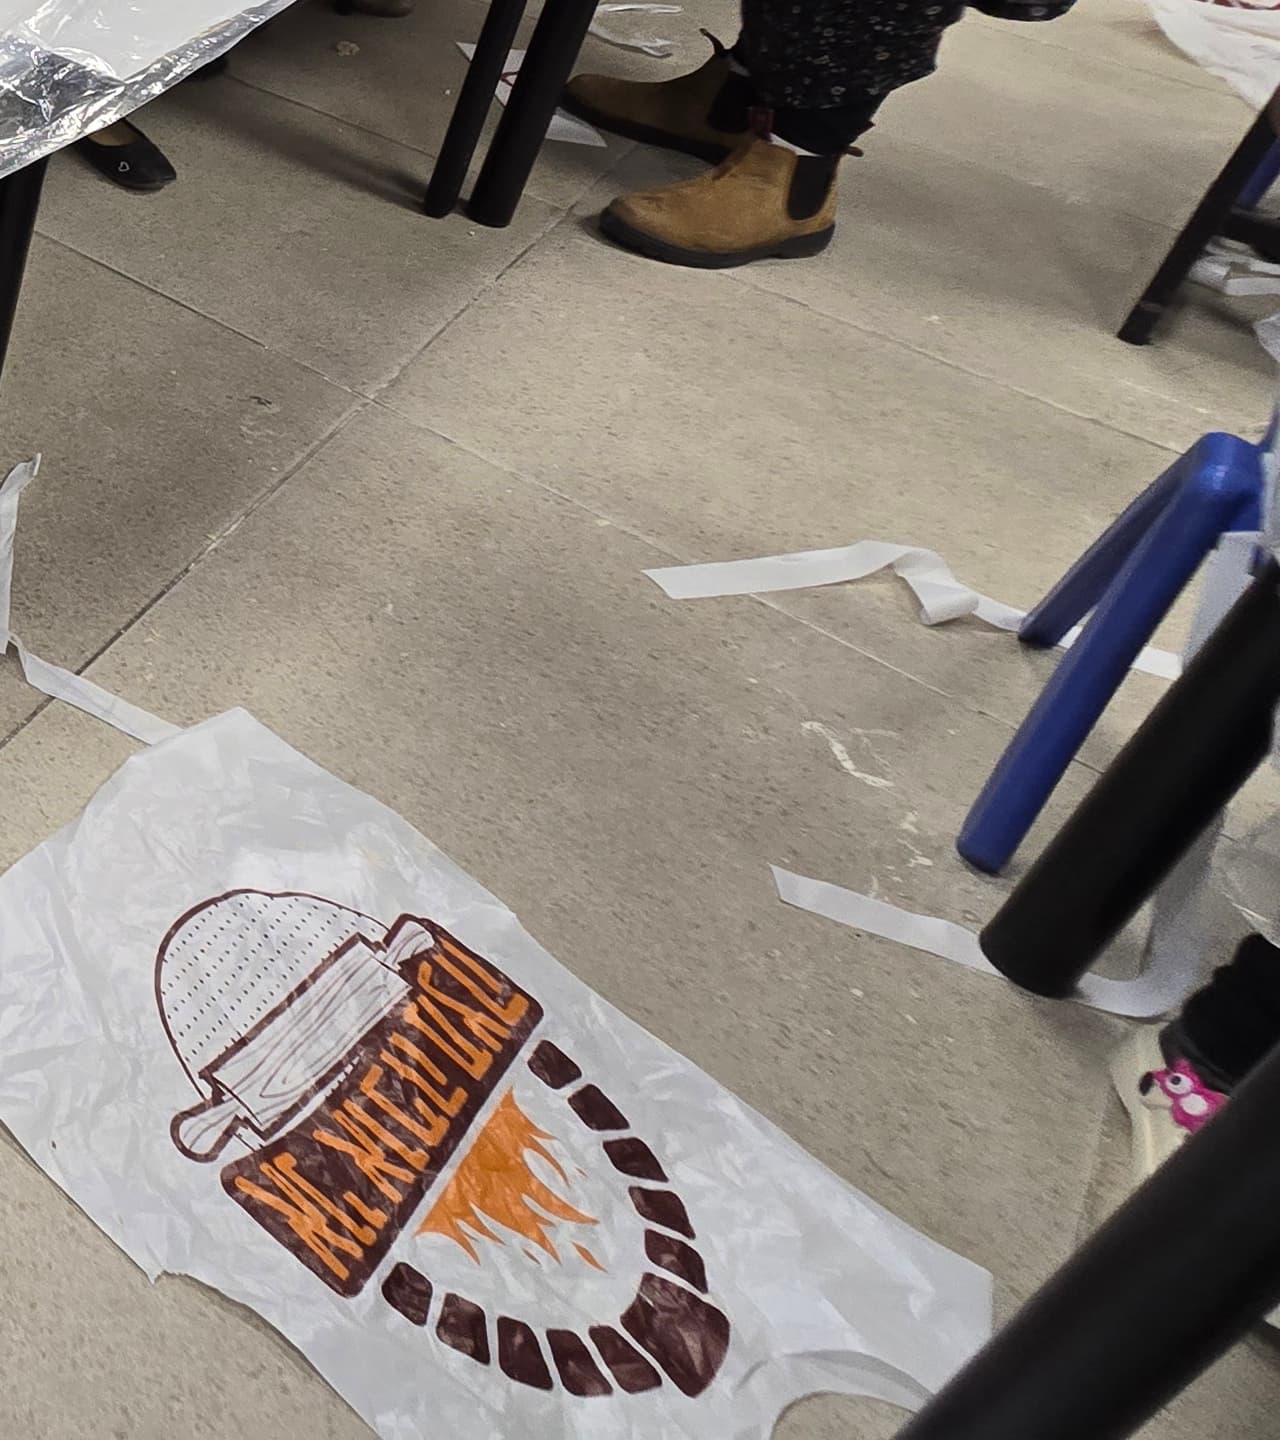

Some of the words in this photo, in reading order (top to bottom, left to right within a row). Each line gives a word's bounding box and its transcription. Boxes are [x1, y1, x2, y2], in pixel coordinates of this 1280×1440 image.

[234, 1151, 390, 1282] אני
[313, 1030, 470, 1204] אופה
[402, 936, 531, 1082] מצה
